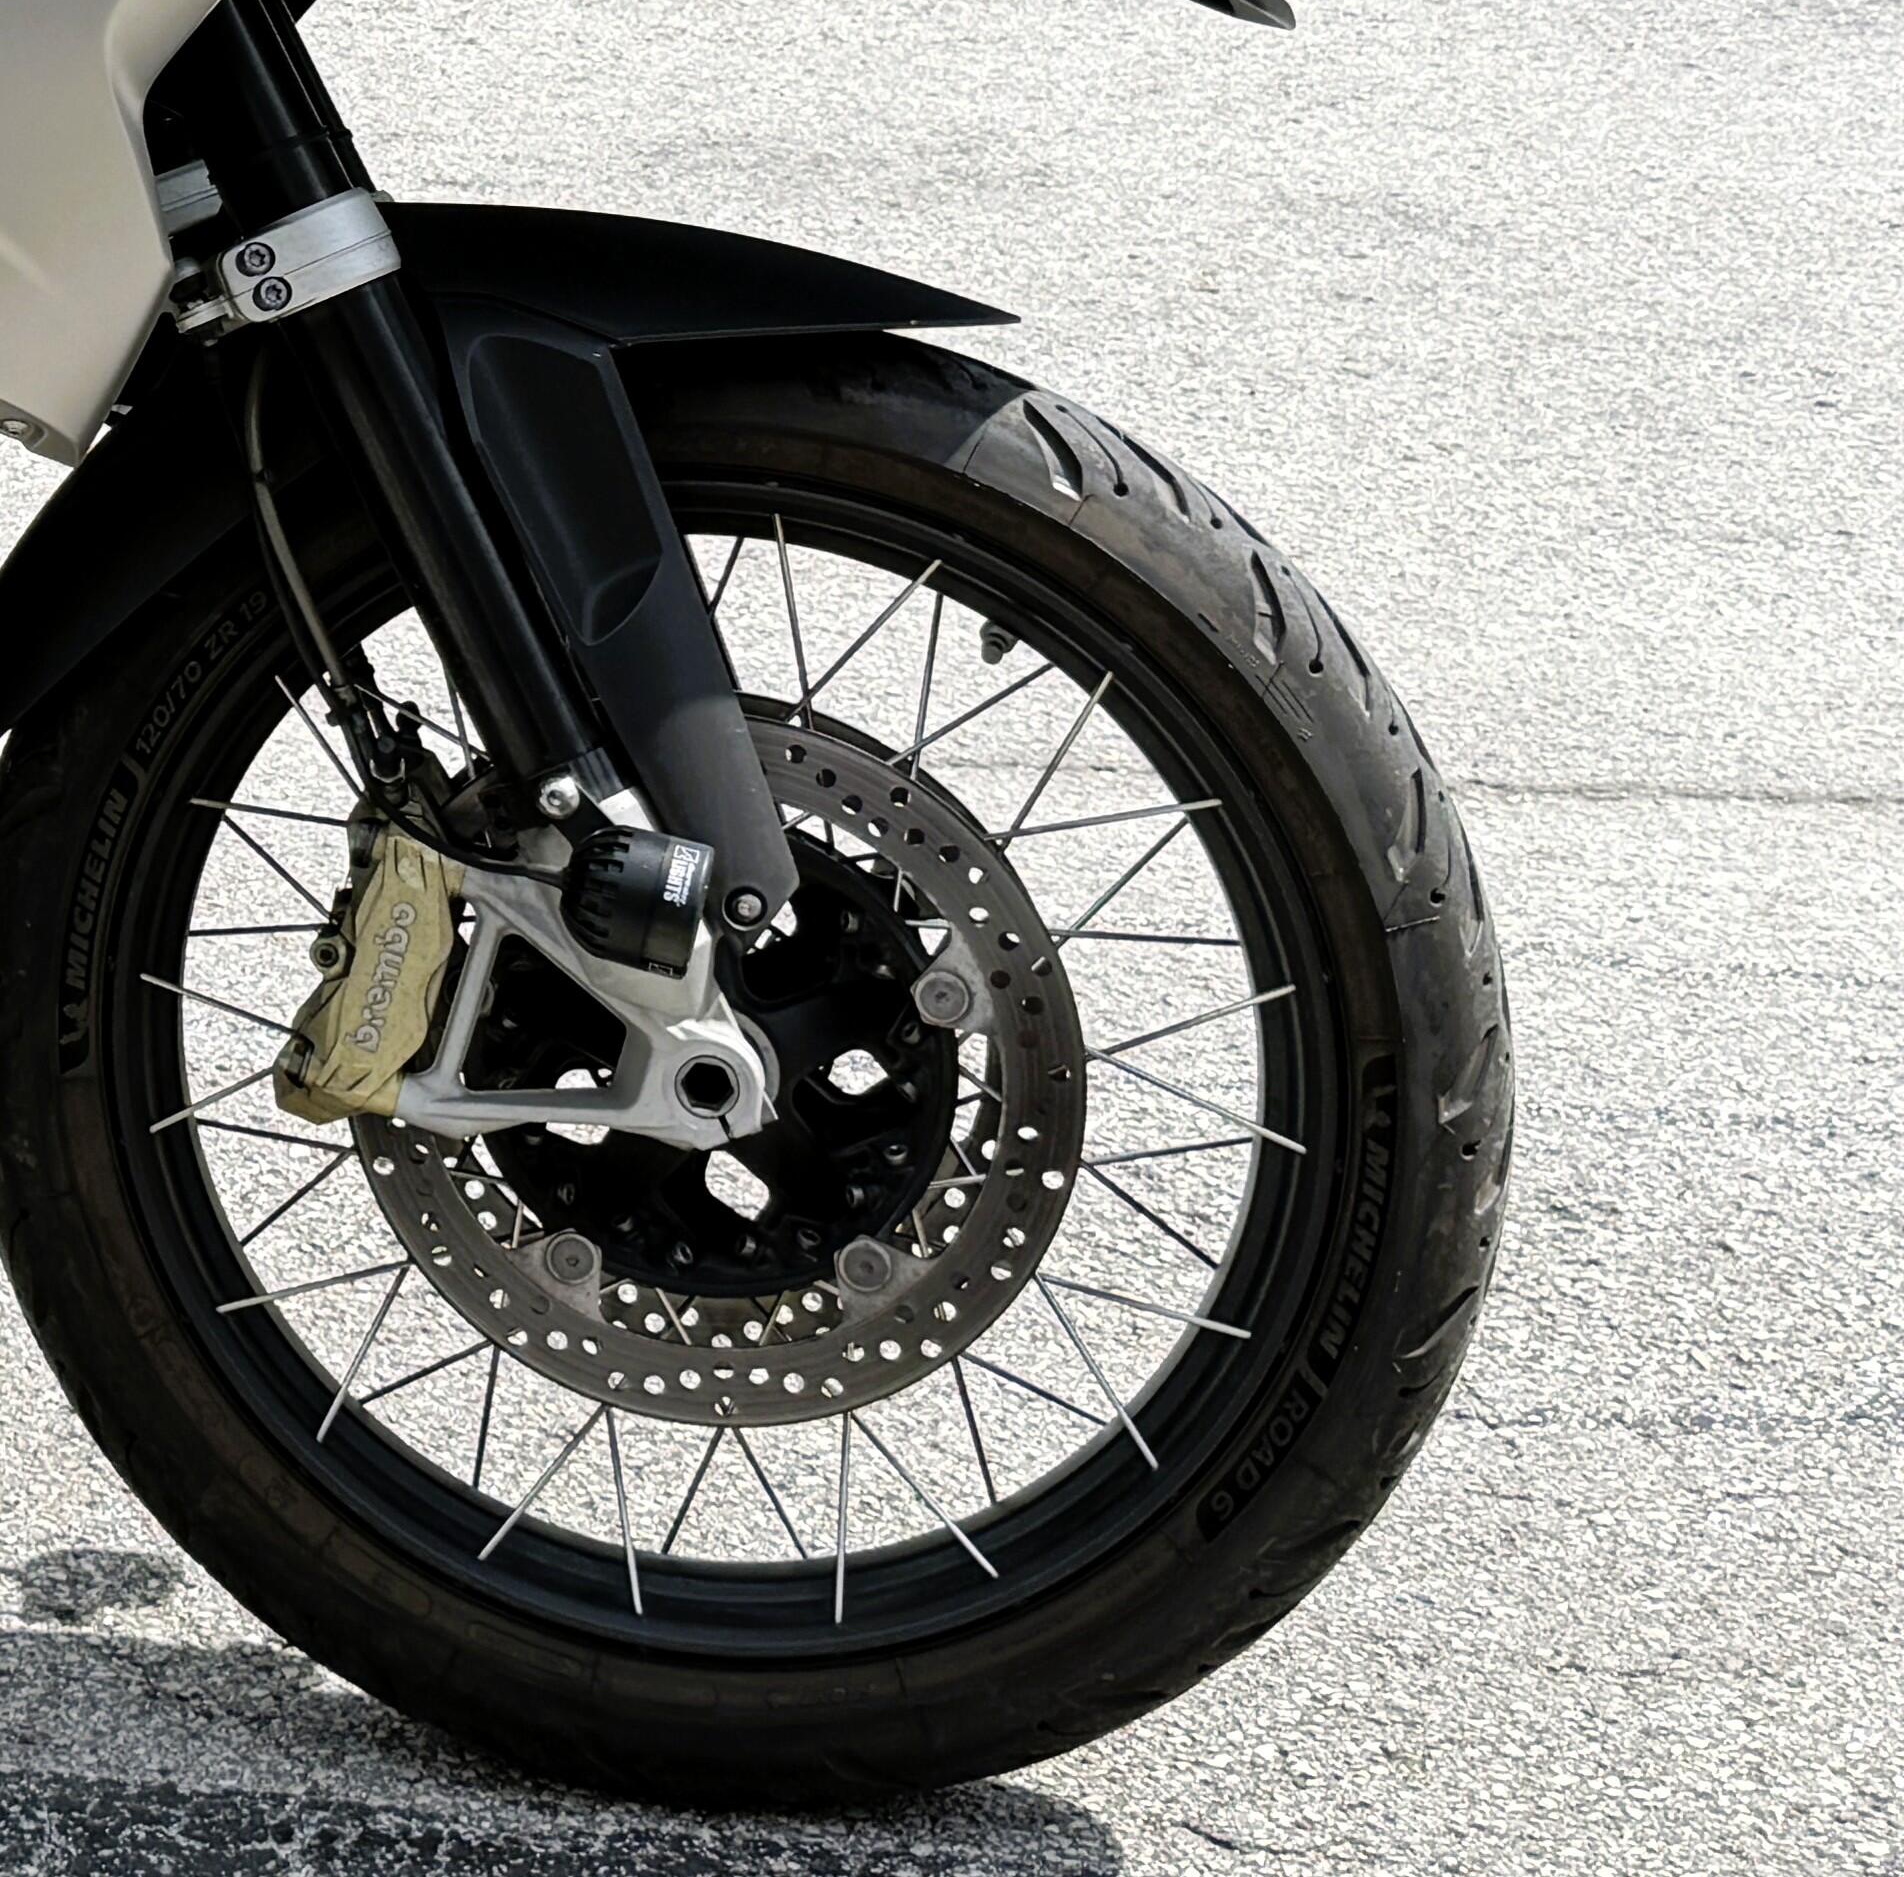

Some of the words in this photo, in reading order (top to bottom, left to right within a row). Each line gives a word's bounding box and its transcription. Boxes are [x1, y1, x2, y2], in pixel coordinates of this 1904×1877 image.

[64, 787, 129, 991] MICHELIN
[134, 660, 203, 755] 120/70
[203, 618, 240, 655] ZR
[239, 589, 269, 620] 19
[344, 902, 416, 1053] brembo
[1318, 1137, 1391, 1361] MICHELIN
[1211, 1495, 1235, 1520] 6
[1234, 1385, 1311, 1492] ROAD
